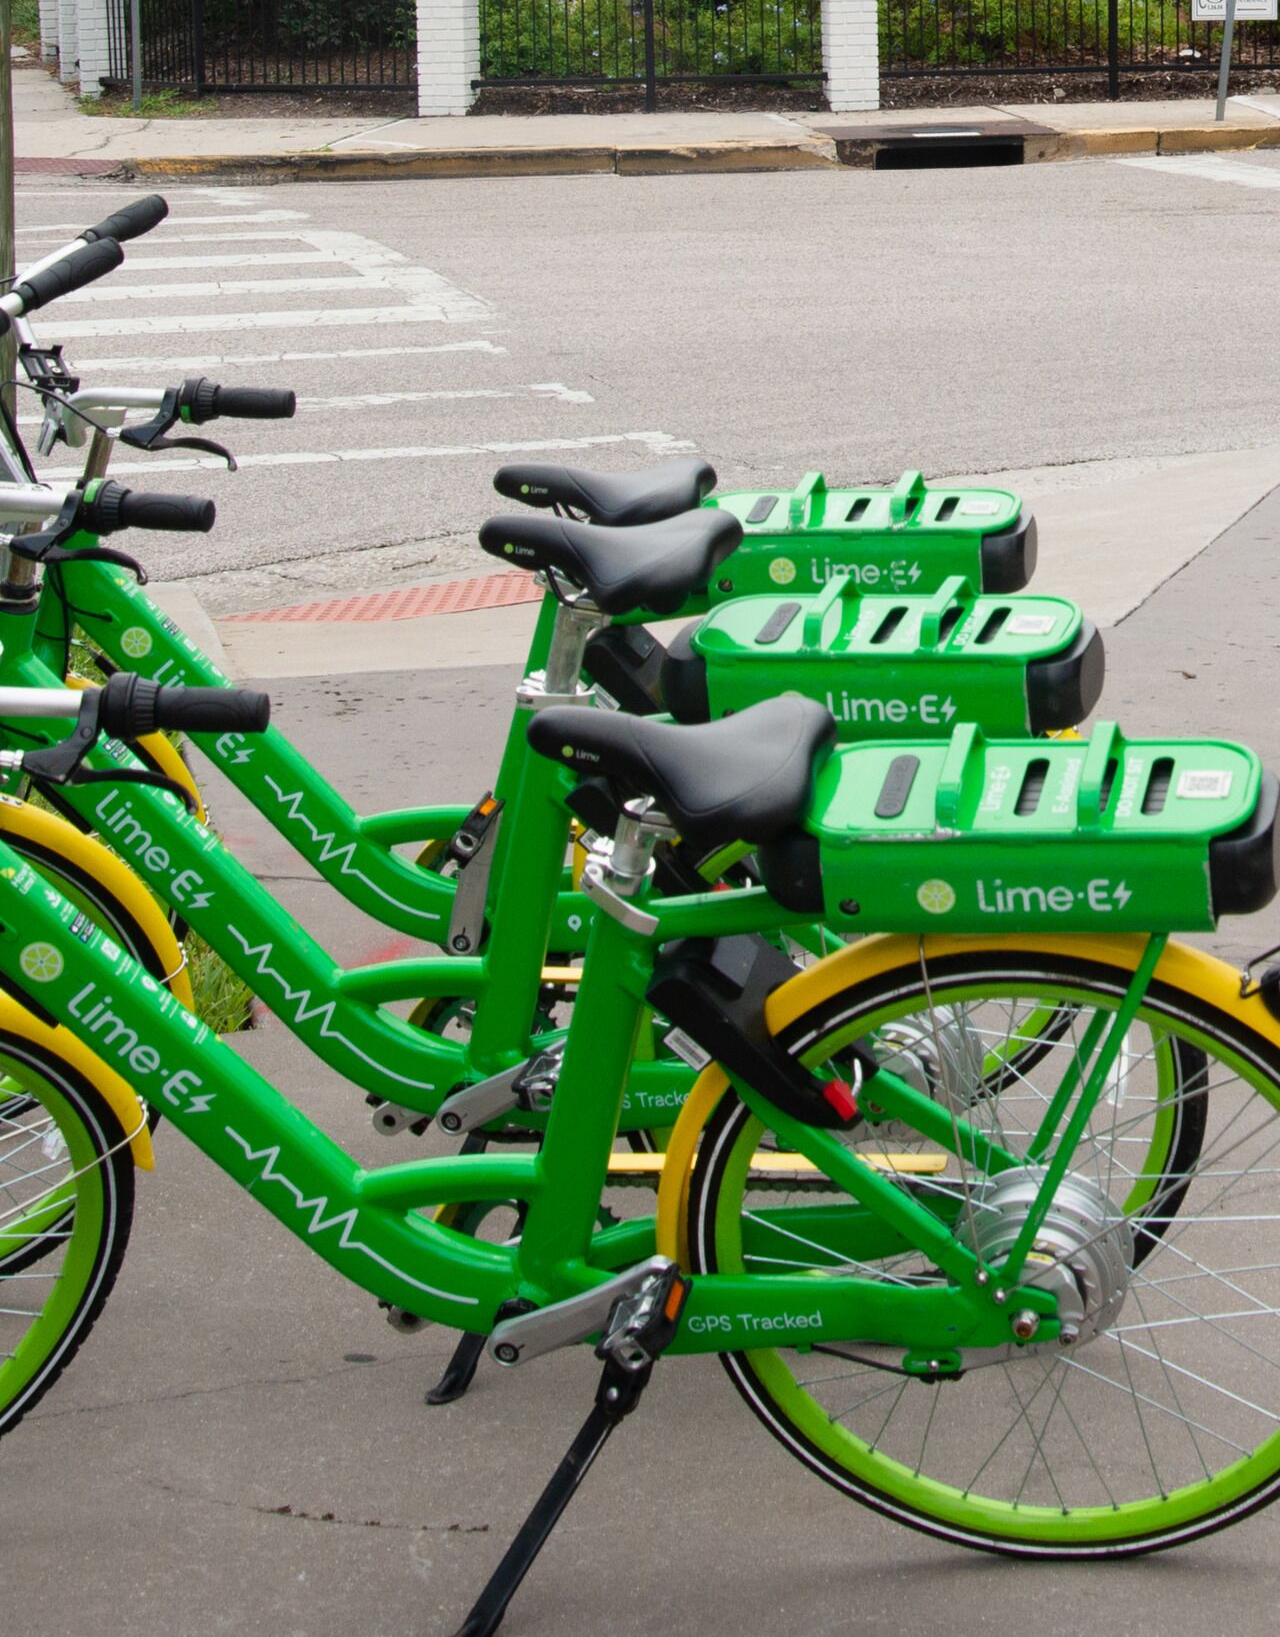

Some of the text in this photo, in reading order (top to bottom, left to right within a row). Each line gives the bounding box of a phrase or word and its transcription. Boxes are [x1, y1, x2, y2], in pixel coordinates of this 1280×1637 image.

[530, 485, 548, 494] Lime
[515, 545, 535, 556] Lime
[576, 748, 600, 763] Lime
[687, 1309, 823, 1333] GPS Tracked
